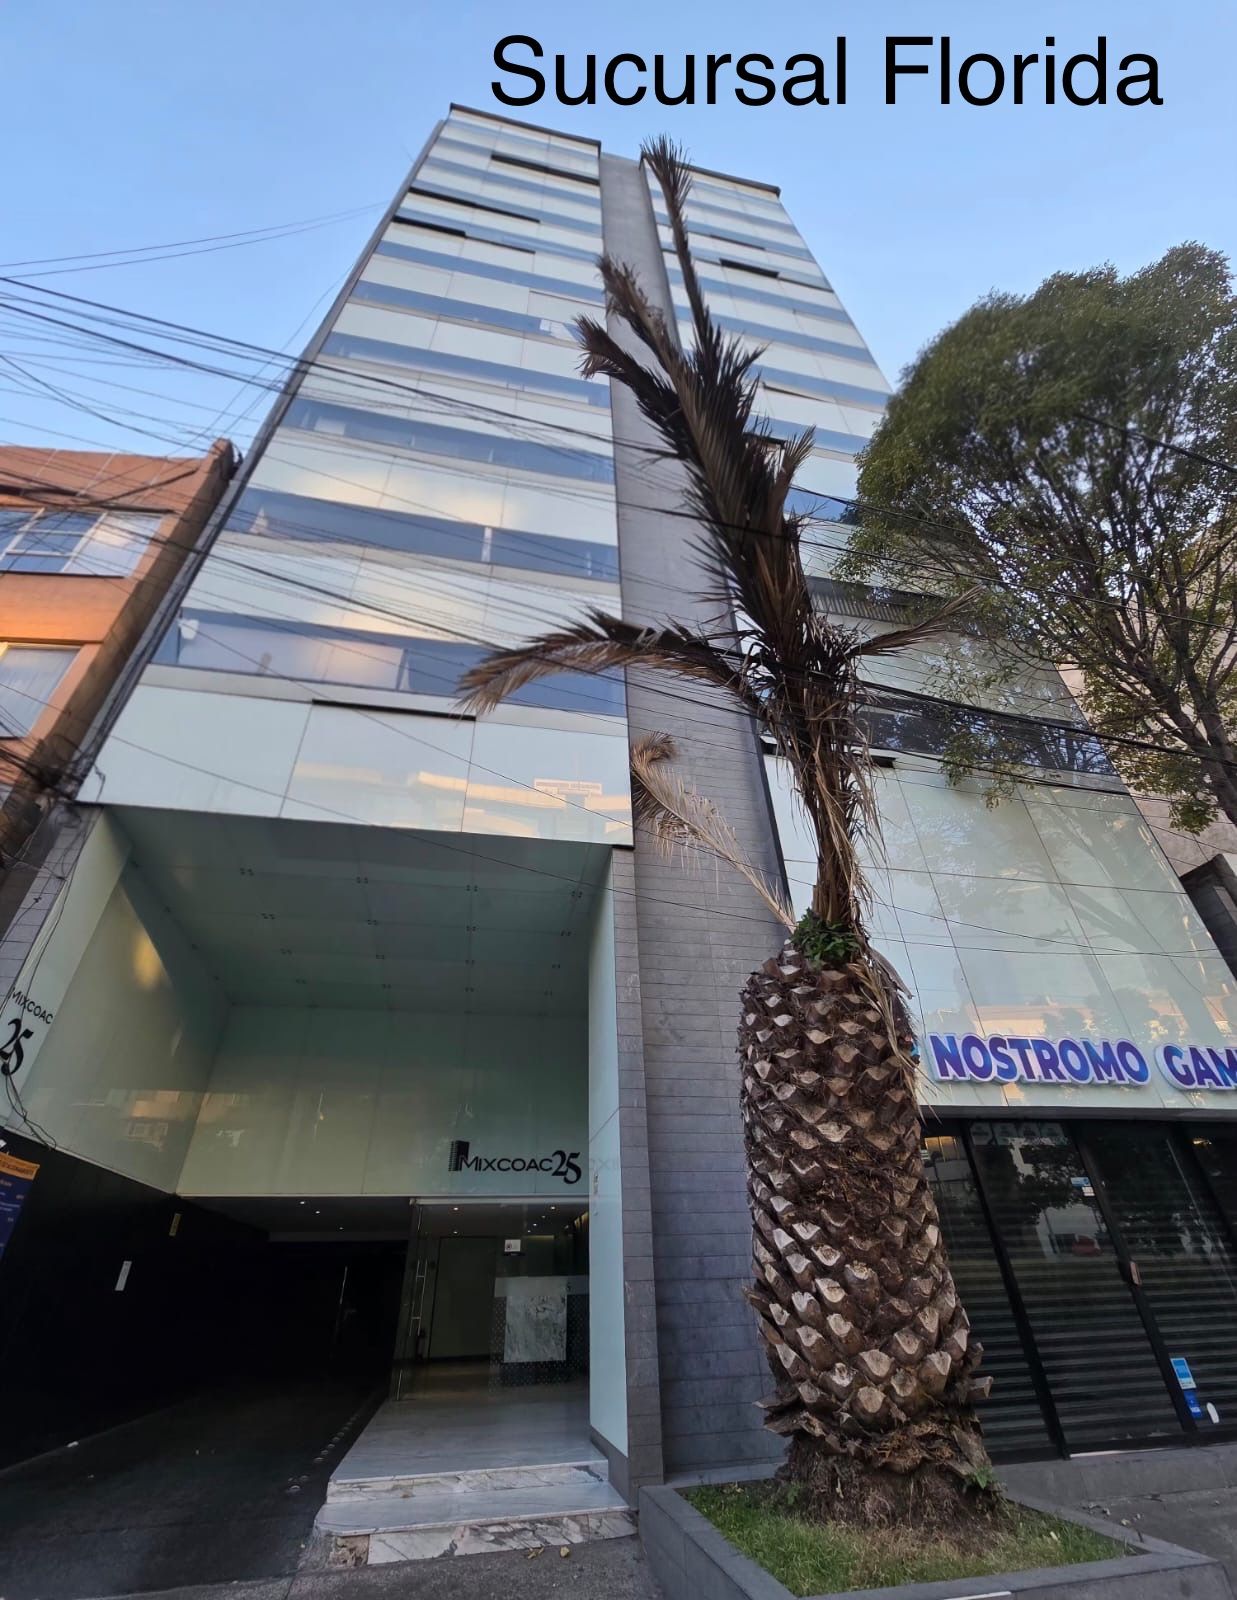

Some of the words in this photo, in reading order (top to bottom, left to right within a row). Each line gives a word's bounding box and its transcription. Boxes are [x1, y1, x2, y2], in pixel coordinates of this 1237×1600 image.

[9, 986, 53, 1024] MIXCOAC
[929, 1035, 1149, 1083] NOSTROMO
[1163, 1045, 1237, 1087] GAM
